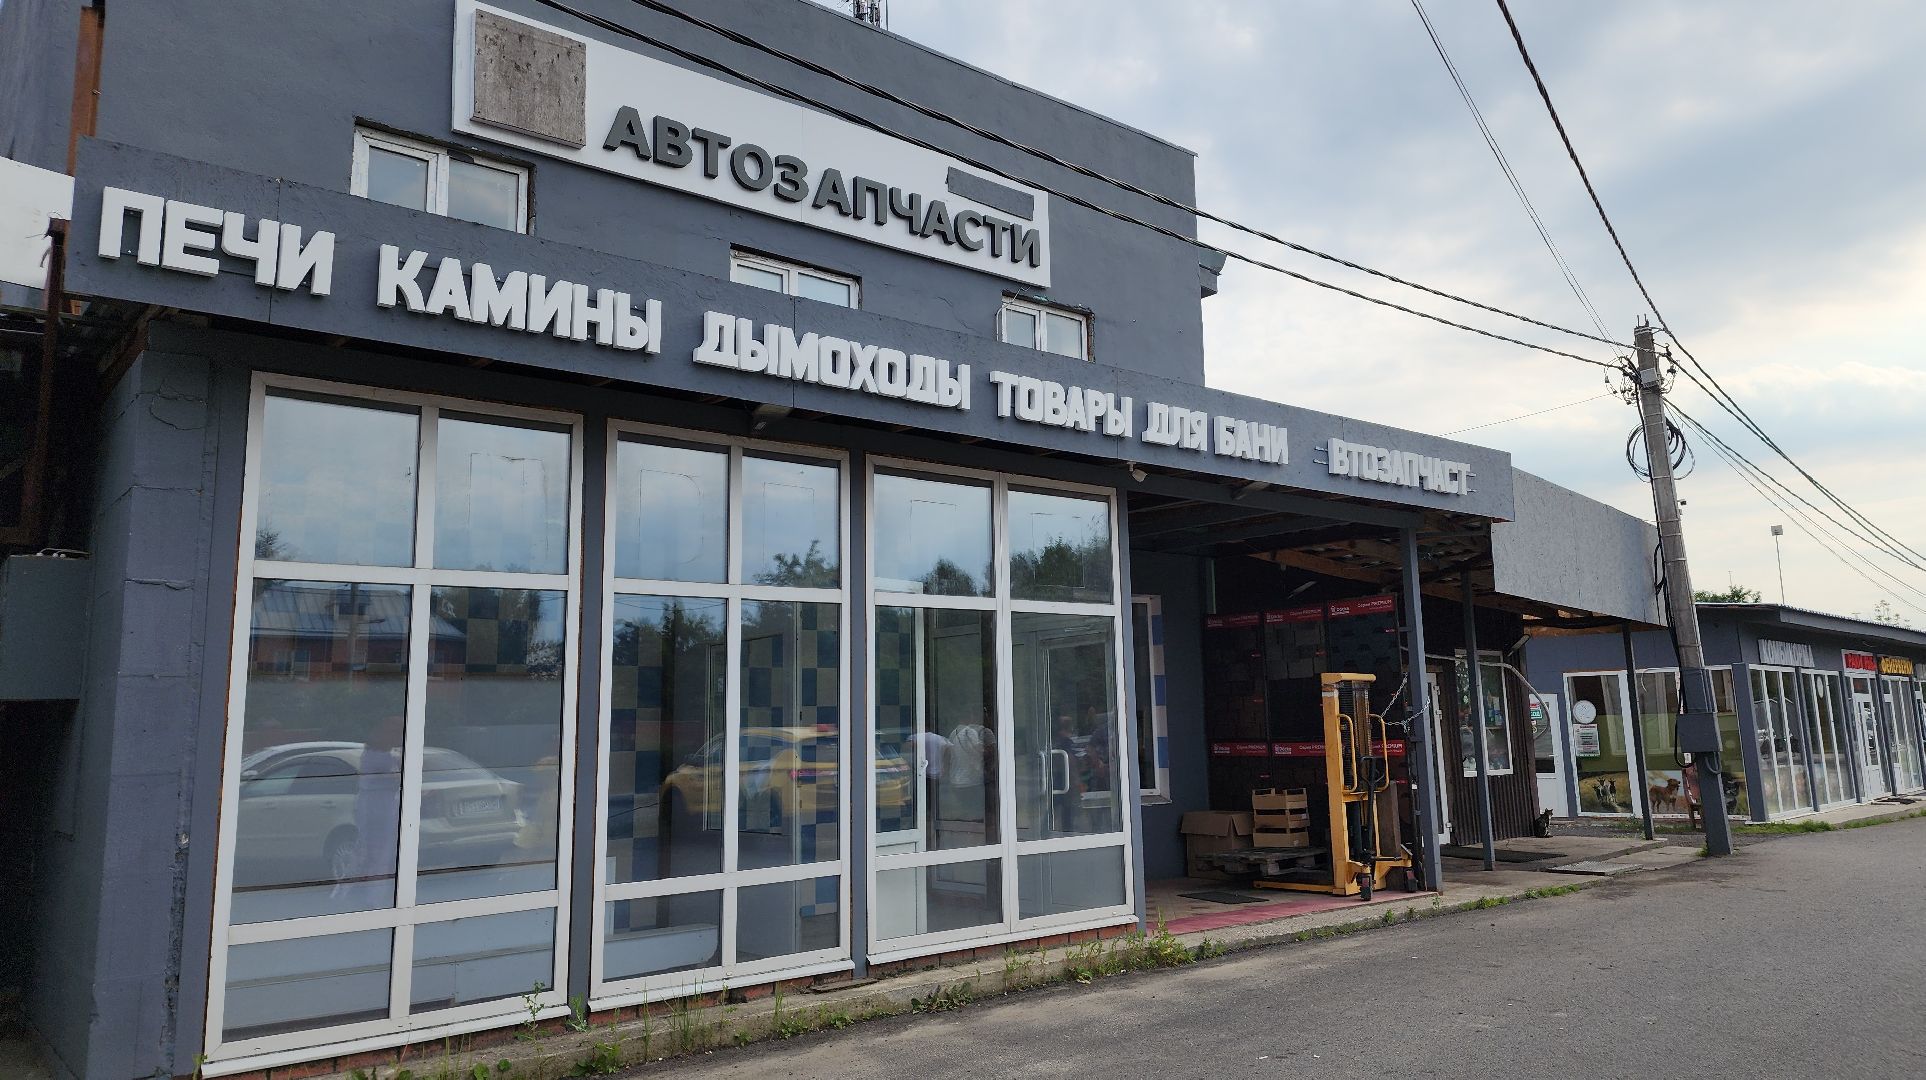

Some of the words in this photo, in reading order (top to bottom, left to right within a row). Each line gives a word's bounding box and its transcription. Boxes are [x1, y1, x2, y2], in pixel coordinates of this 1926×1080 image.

[603, 105, 1040, 267] АВТОЗАПЧАСТИ
[99, 186, 335, 295] ПЕЧИ
[376, 243, 662, 354] КАМИНЫ
[693, 310, 971, 410] ДЫМОХОДЫ
[990, 370, 1132, 438] ТОВАРЫ
[1142, 402, 1207, 451] ДЛЯ
[1214, 415, 1289, 464] БАНИ
[1328, 437, 1470, 495] ВТОЗАПЧАСТ
